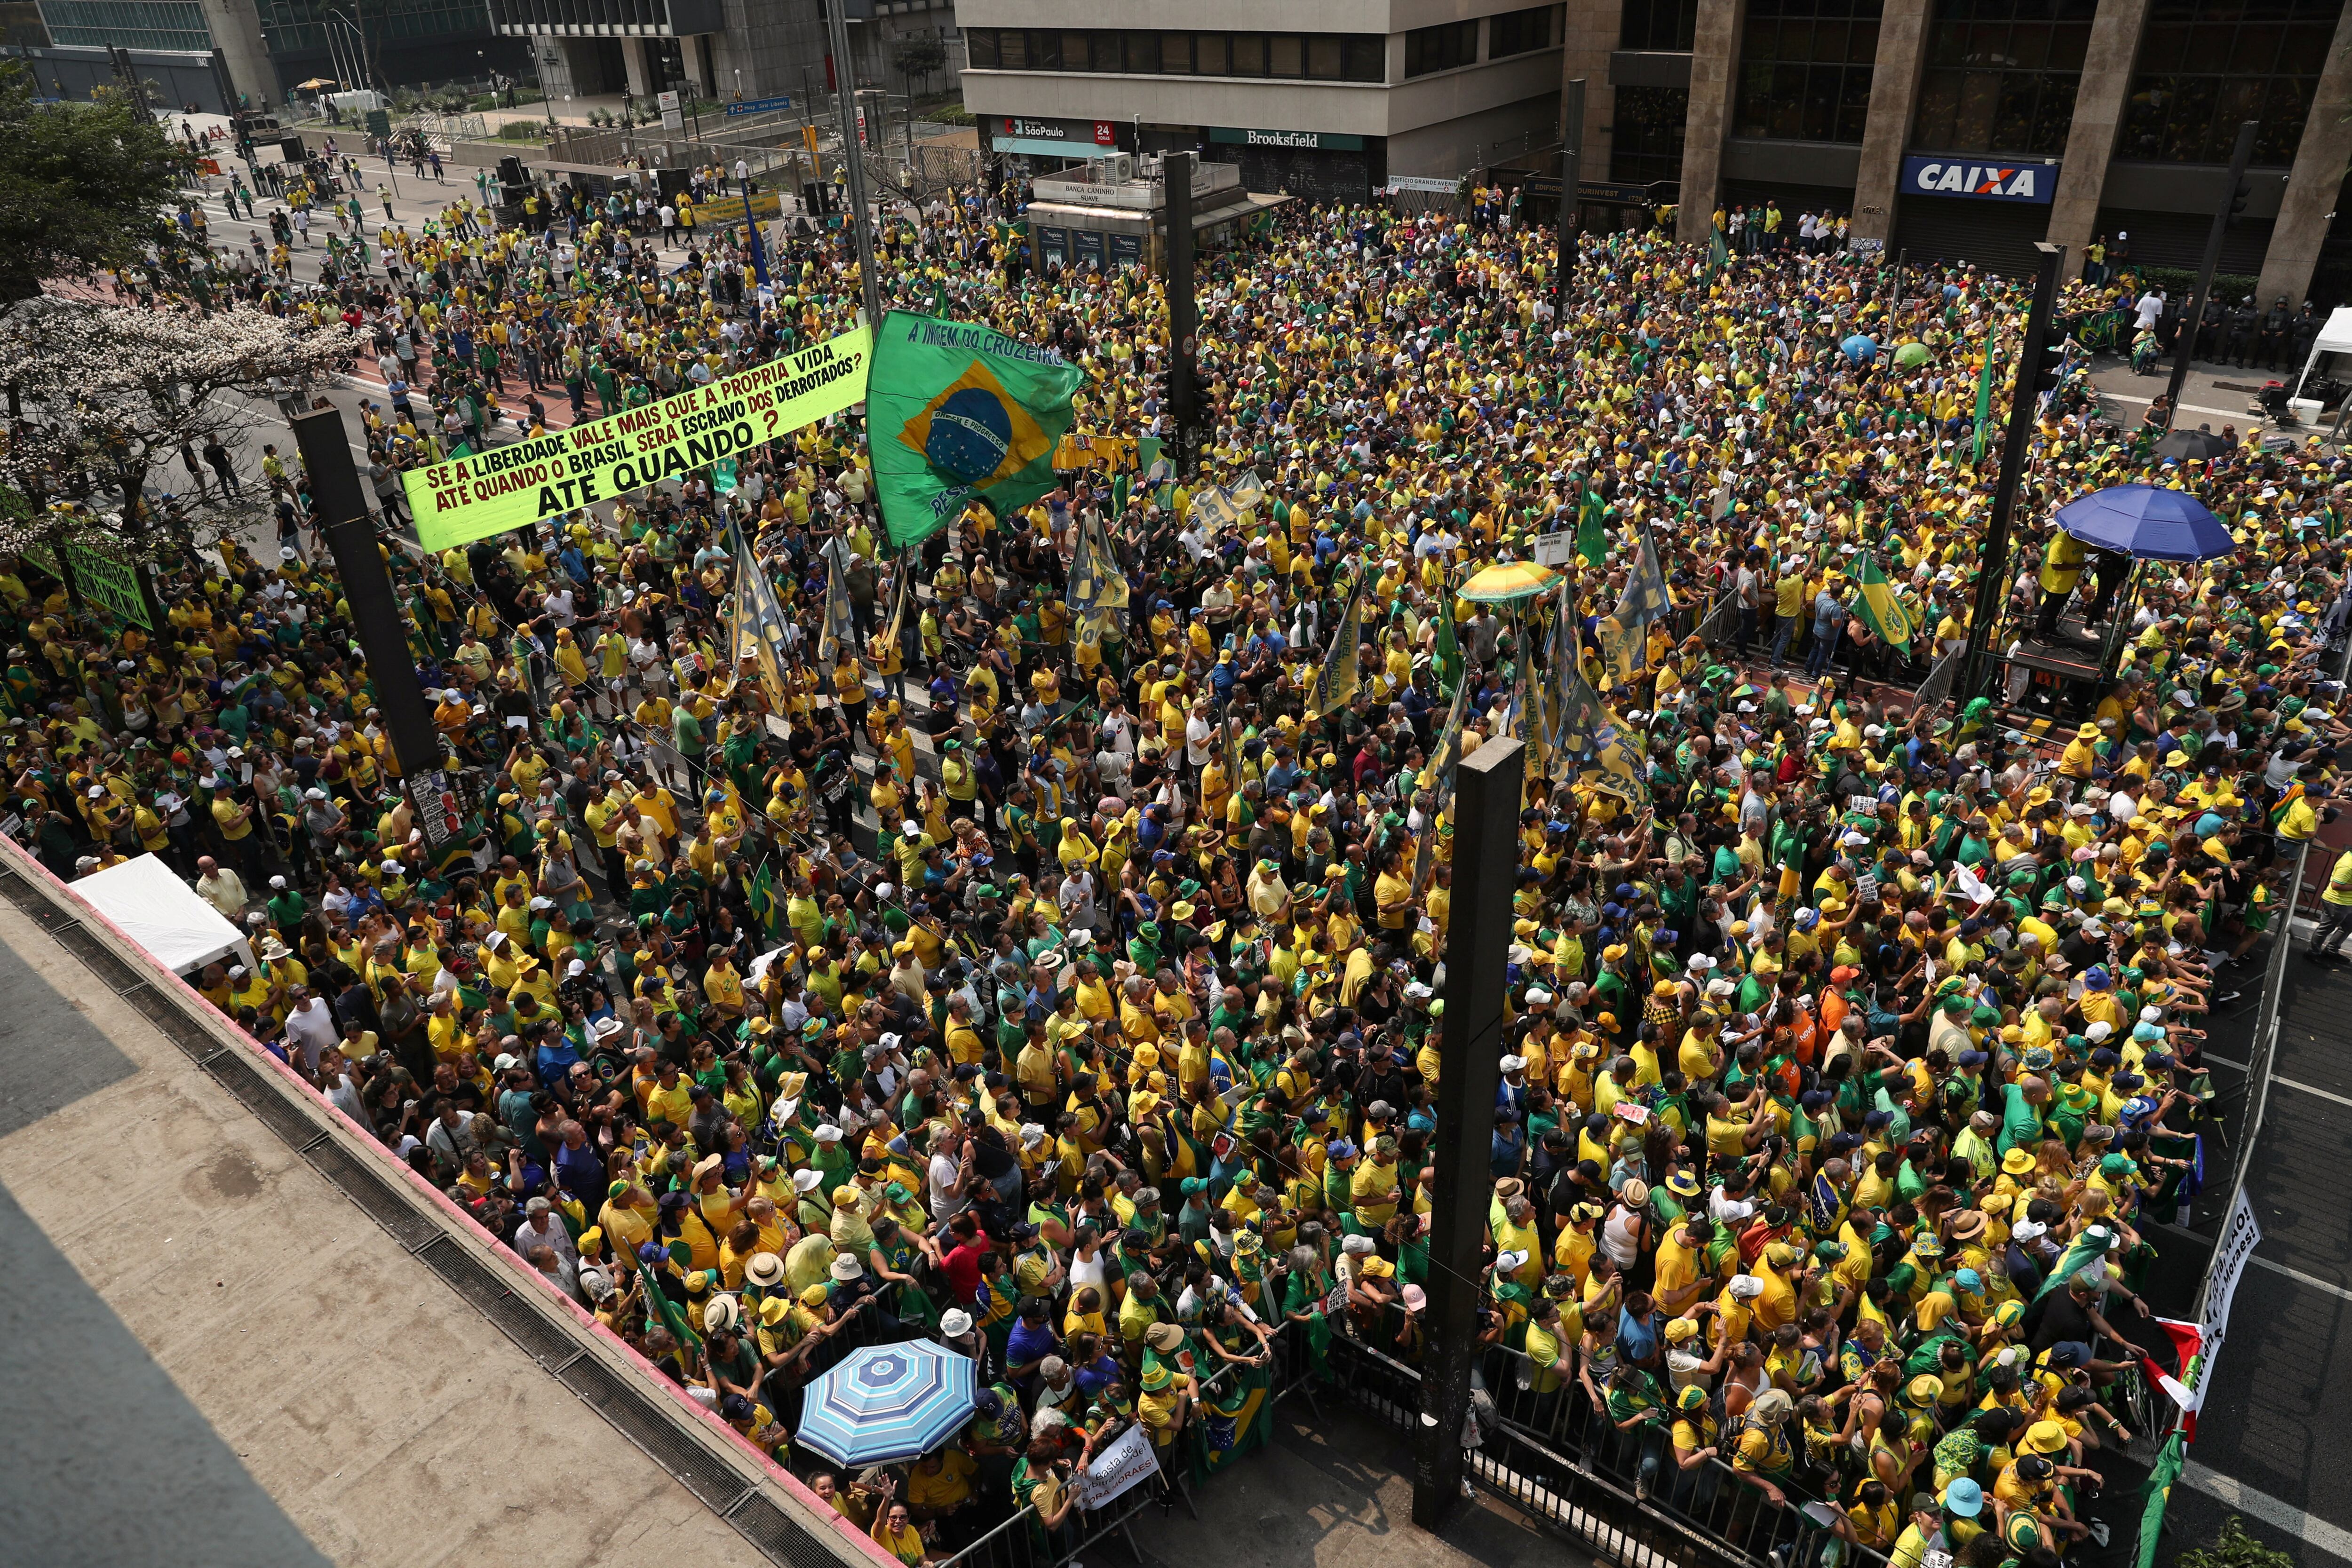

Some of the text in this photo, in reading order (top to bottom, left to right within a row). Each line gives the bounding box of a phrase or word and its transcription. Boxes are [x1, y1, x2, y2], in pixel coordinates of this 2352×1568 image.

[196, 57, 208, 66] 1842
[125, 65, 143, 107] Rocha Azevedo
[1025, 126, 1064, 137] SãoPaulo
[1097, 125, 1110, 135] 24
[1247, 130, 1318, 147] Brooksfield
[1918, 164, 2034, 197] CAIXA
[1087, 186, 1114, 195] CAMINHO
[1578, 188, 1619, 197] OURINVEST
[907, 321, 920, 343] A
[962, 329, 979, 349] DO
[986, 333, 1067, 367] CRUZEIRO
[426, 466, 456, 488] SE
[456, 461, 471, 483] A
[471, 434, 568, 477] LIBERDADE
[570, 421, 614, 449] VALE
[617, 406, 661, 436] MAIS
[665, 392, 699, 420] QUE
[705, 387, 718, 407] A
[721, 362, 790, 400] PRÓPRIA
[970, 421, 1004, 449] PROGRESSO
[435, 481, 472, 513] ATÉ
[474, 464, 548, 500] QUANDO
[551, 459, 564, 479] O
[568, 440, 634, 474] BRASIL
[636, 420, 680, 452] SERÁ
[681, 400, 746, 437] ESCRAVO
[747, 390, 774, 414] DOS
[537, 410, 779, 517] ATÉ QUANDO ?
[758, 529, 785, 545] IMPEACHMEN
[1342, 620, 1353, 659] MIGUEL
[677, 655, 691, 665] #FORA
[681, 662, 694, 672] #FORA
[1525, 684, 1540, 728] MIGUEL
[412, 779, 430, 790] DEMOCRACY
[421, 796, 440, 809] #FORA
[423, 802, 443, 816] #FORA
[432, 828, 445, 837] VAMOS
[1799, 1024, 1815, 1041] NOVO
[2224, 1225, 2256, 1289] Moraes!
[1341, 1267, 1346, 1276] 3
[1005, 1409, 1020, 1434] BRASIL
[1096, 1444, 1133, 1481] Basta de
[1112, 1457, 1154, 1491] MORAES!
